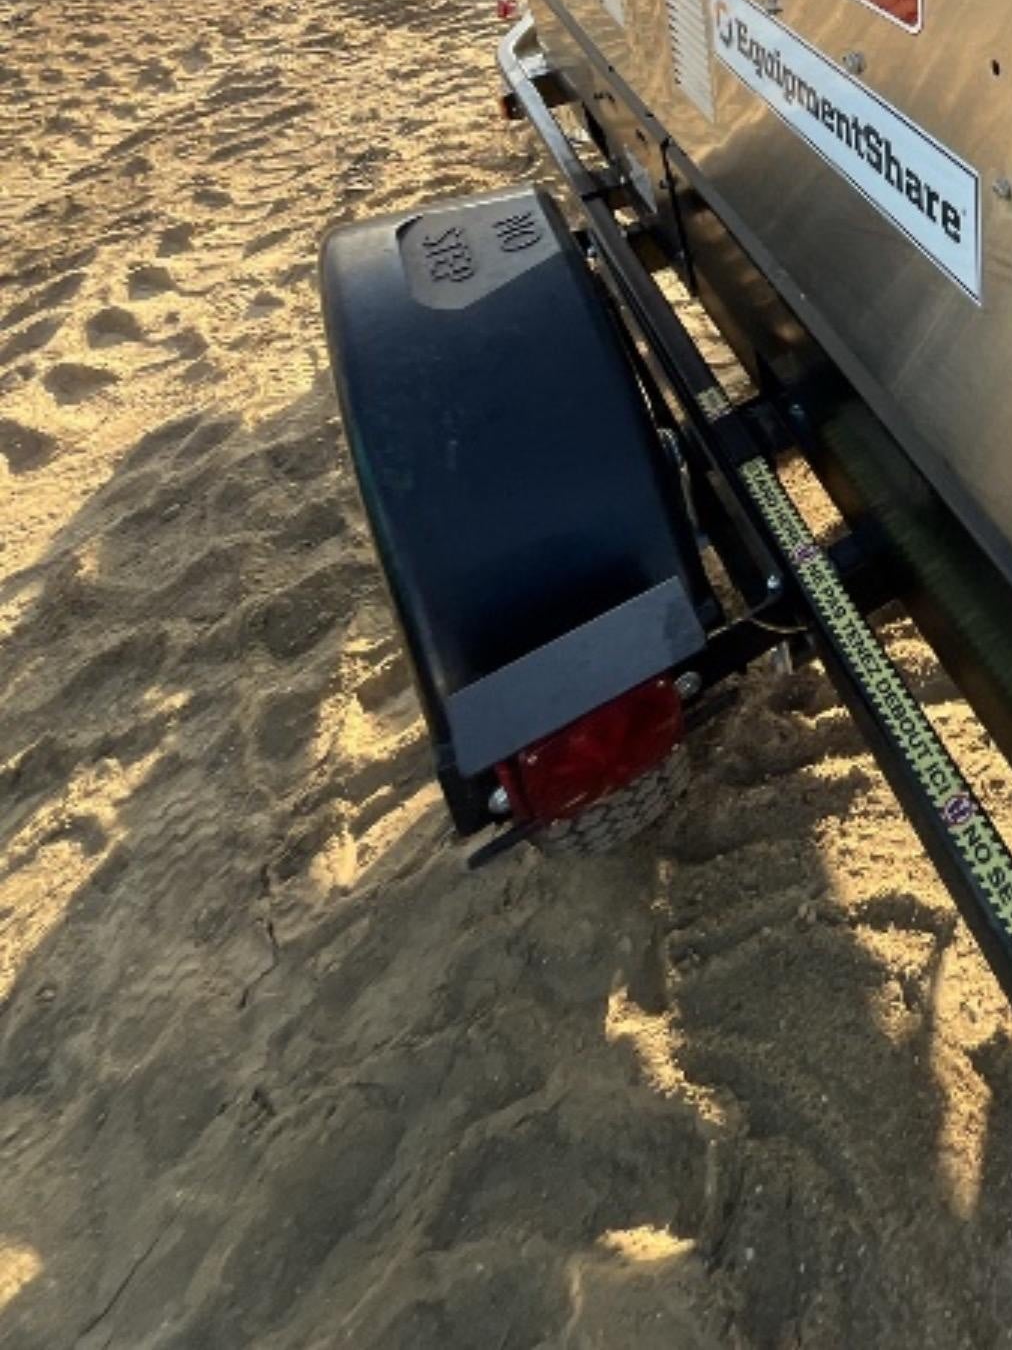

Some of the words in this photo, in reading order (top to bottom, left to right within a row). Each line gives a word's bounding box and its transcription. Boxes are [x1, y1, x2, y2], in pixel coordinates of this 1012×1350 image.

[732, 16, 964, 246] EquipmentShare
[842, 617, 883, 679] TENEZ
[875, 678, 934, 760] DEBOUT
[925, 761, 951, 796] ICI
[961, 824, 993, 866] NO
